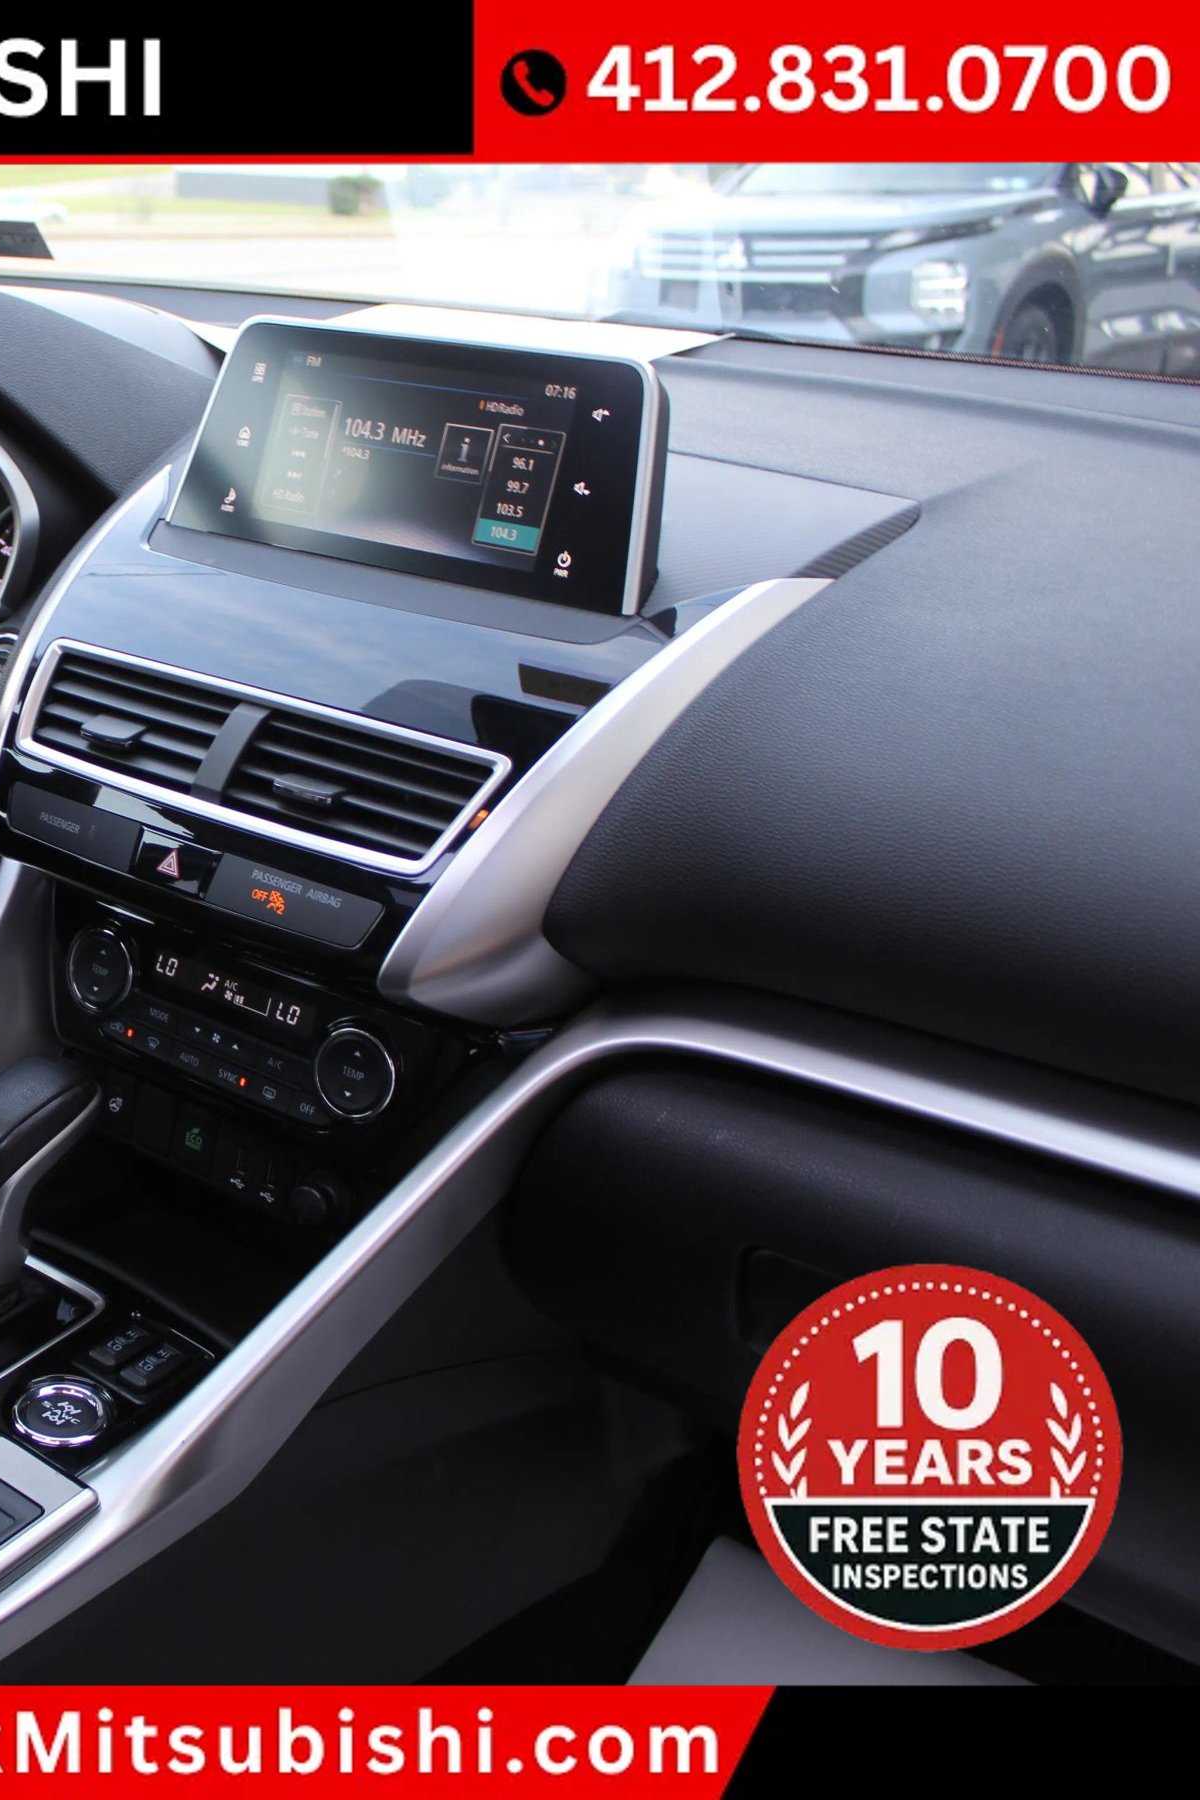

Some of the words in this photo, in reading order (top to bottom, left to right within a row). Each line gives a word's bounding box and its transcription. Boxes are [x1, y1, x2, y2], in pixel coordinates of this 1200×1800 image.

[306, 355, 322, 367] FM
[544, 383, 577, 400] 07:16
[345, 417, 386, 441] 104.3
[392, 426, 427, 448] MHz
[512, 456, 535, 472] 96.1
[506, 479, 530, 495] 99.7
[496, 502, 524, 518] 103.5
[490, 525, 518, 541] 104.3
[39, 811, 80, 835] PASSENGER
[251, 868, 303, 895] PASSENGER
[305, 888, 343, 909] AIRBAG
[251, 888, 269, 902] OFF
[224, 979, 239, 992] A/C
[149, 1006, 170, 1023] MODE
[179, 1051, 200, 1068] AUTO
[267, 1056, 284, 1072] A/C
[217, 1067, 239, 1086] SYNC
[342, 1065, 366, 1082] TEMP
[299, 1101, 316, 1117] OFF
